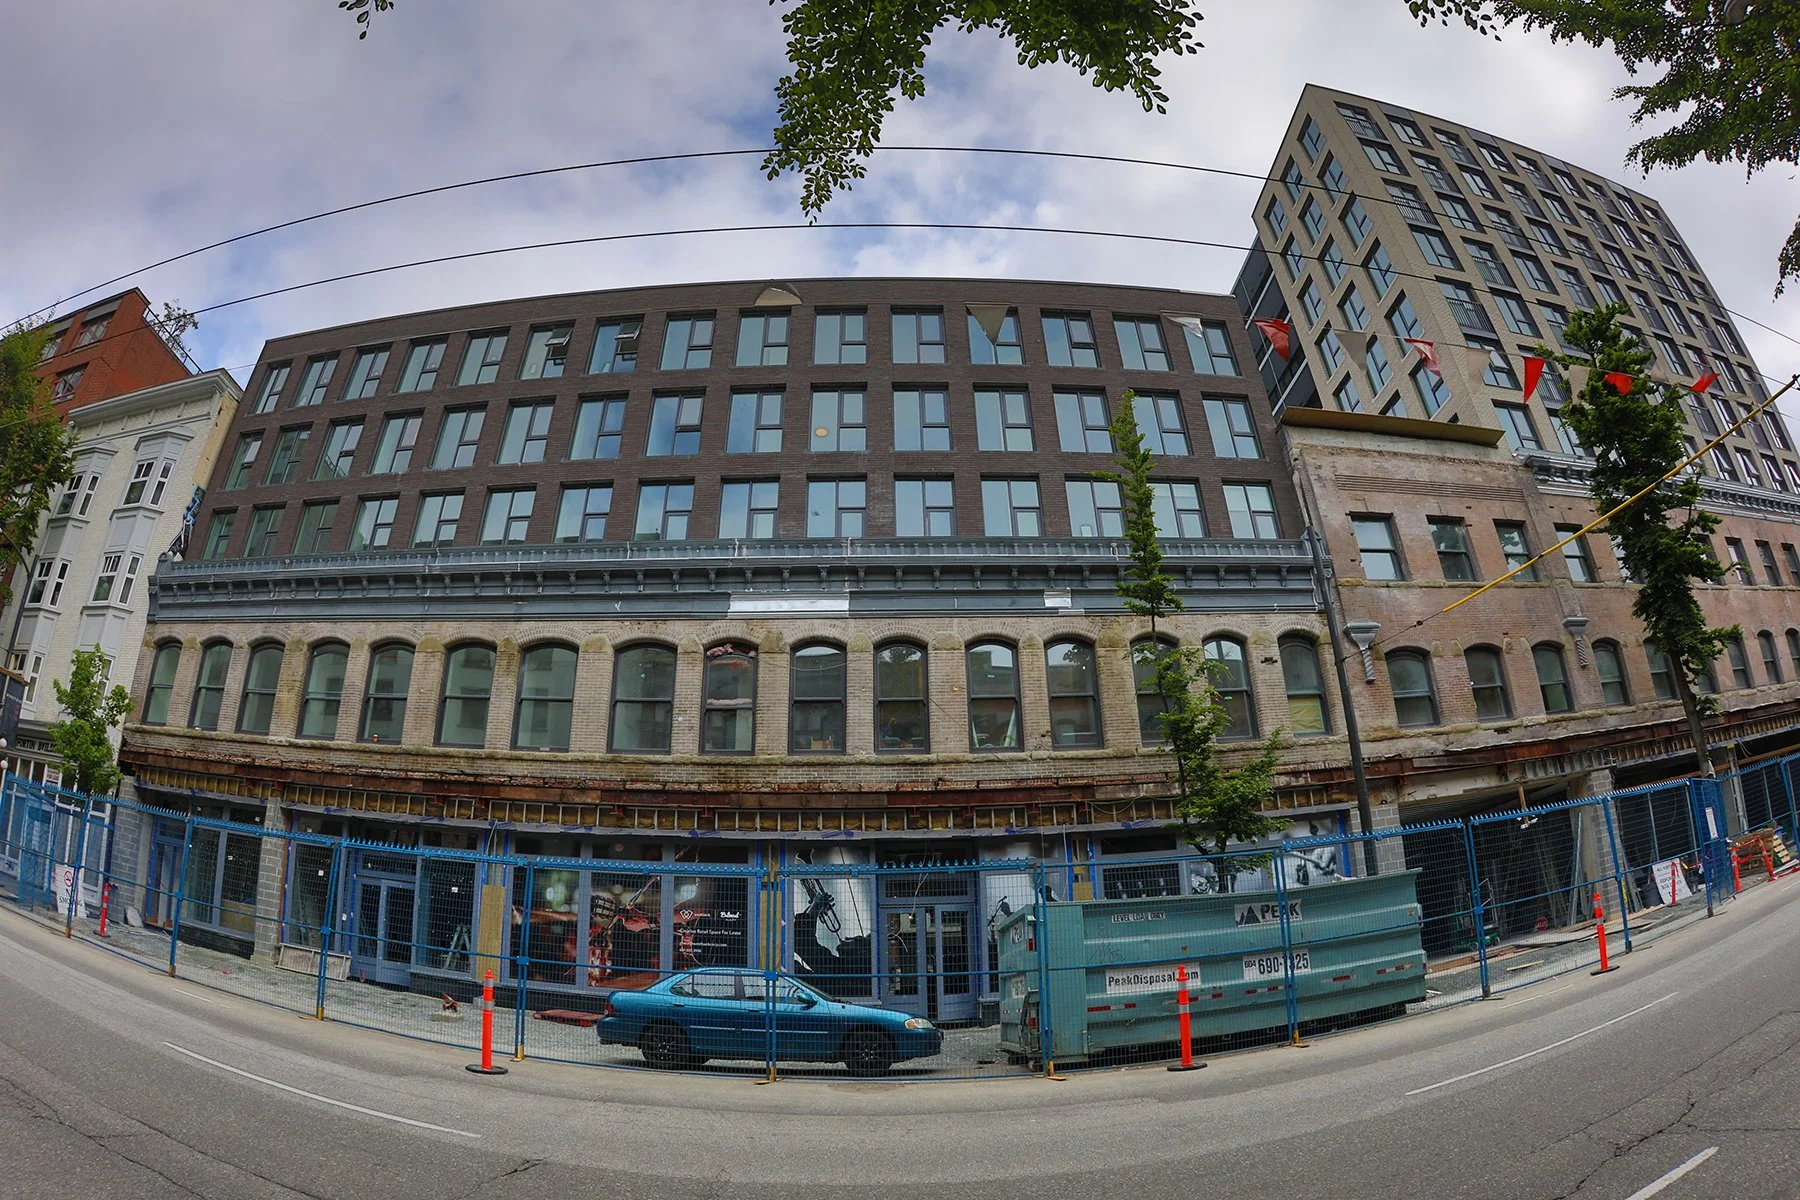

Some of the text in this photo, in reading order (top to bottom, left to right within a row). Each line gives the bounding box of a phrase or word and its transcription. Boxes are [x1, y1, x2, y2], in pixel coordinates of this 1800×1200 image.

[1113, 914, 1131, 922] LEVEL
[1244, 960, 1257, 969] 604
[1108, 971, 1199, 987] PeakDisposal.om
